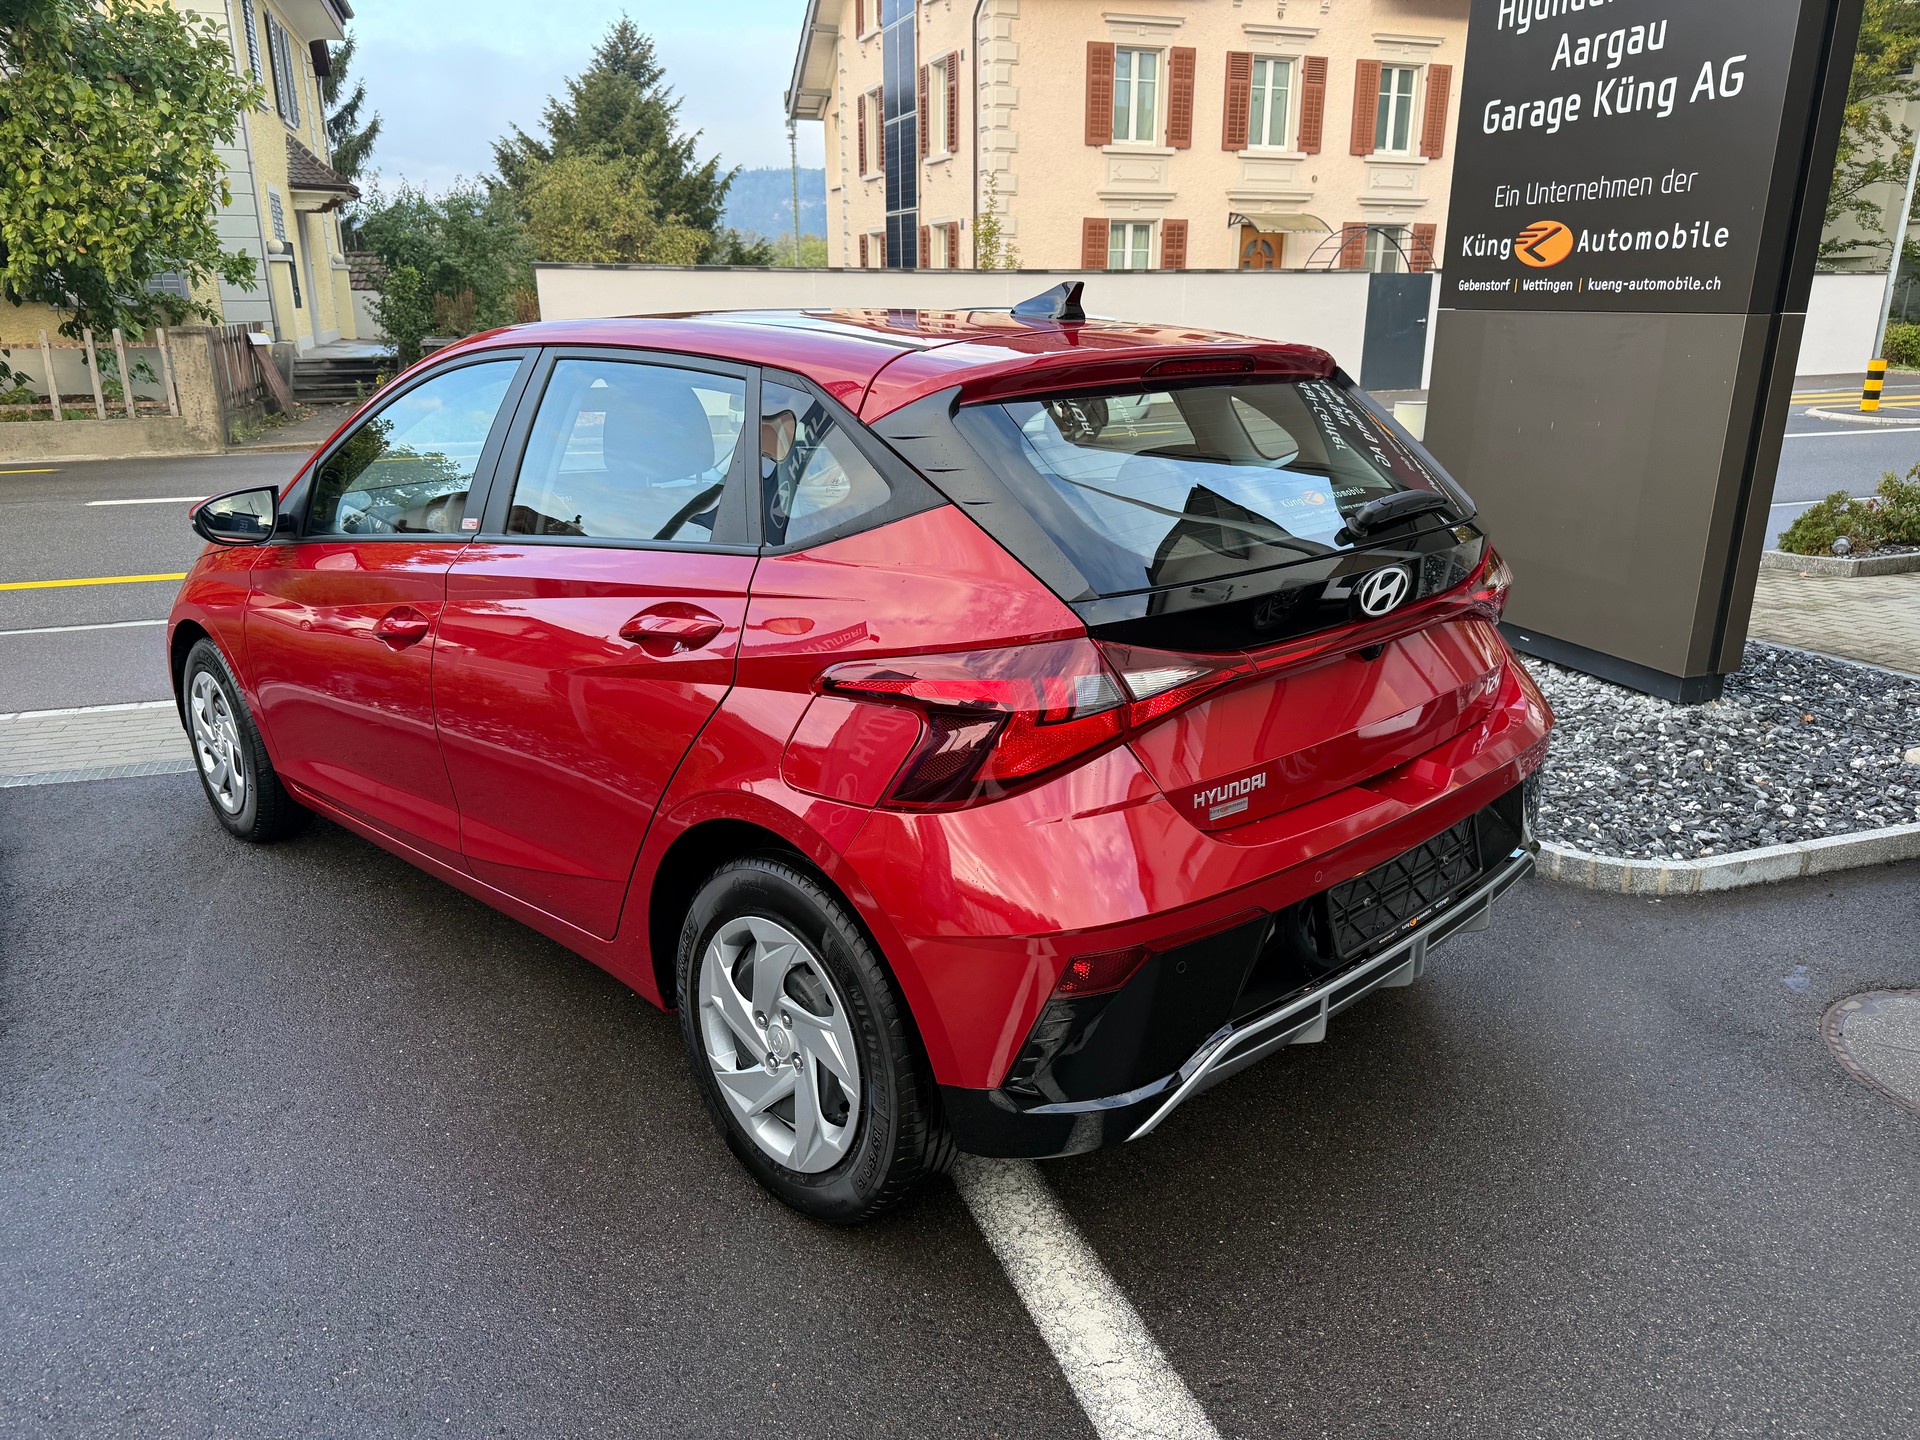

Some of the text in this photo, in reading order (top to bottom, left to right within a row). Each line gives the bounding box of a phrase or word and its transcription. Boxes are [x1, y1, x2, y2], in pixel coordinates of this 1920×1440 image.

[1550, 19, 1668, 71] Aargau
[1482, 54, 1748, 135] Garage Küng AG
[1494, 168, 1699, 208] Ein Unternehmen der
[1462, 220, 1730, 260] Küng Automobile
[1458, 275, 1722, 293] Gebenstorf Wettingen kueng-automobile.ch
[1193, 772, 1267, 809] HYUNDAI
[850, 985, 887, 1113] MICHELIN
